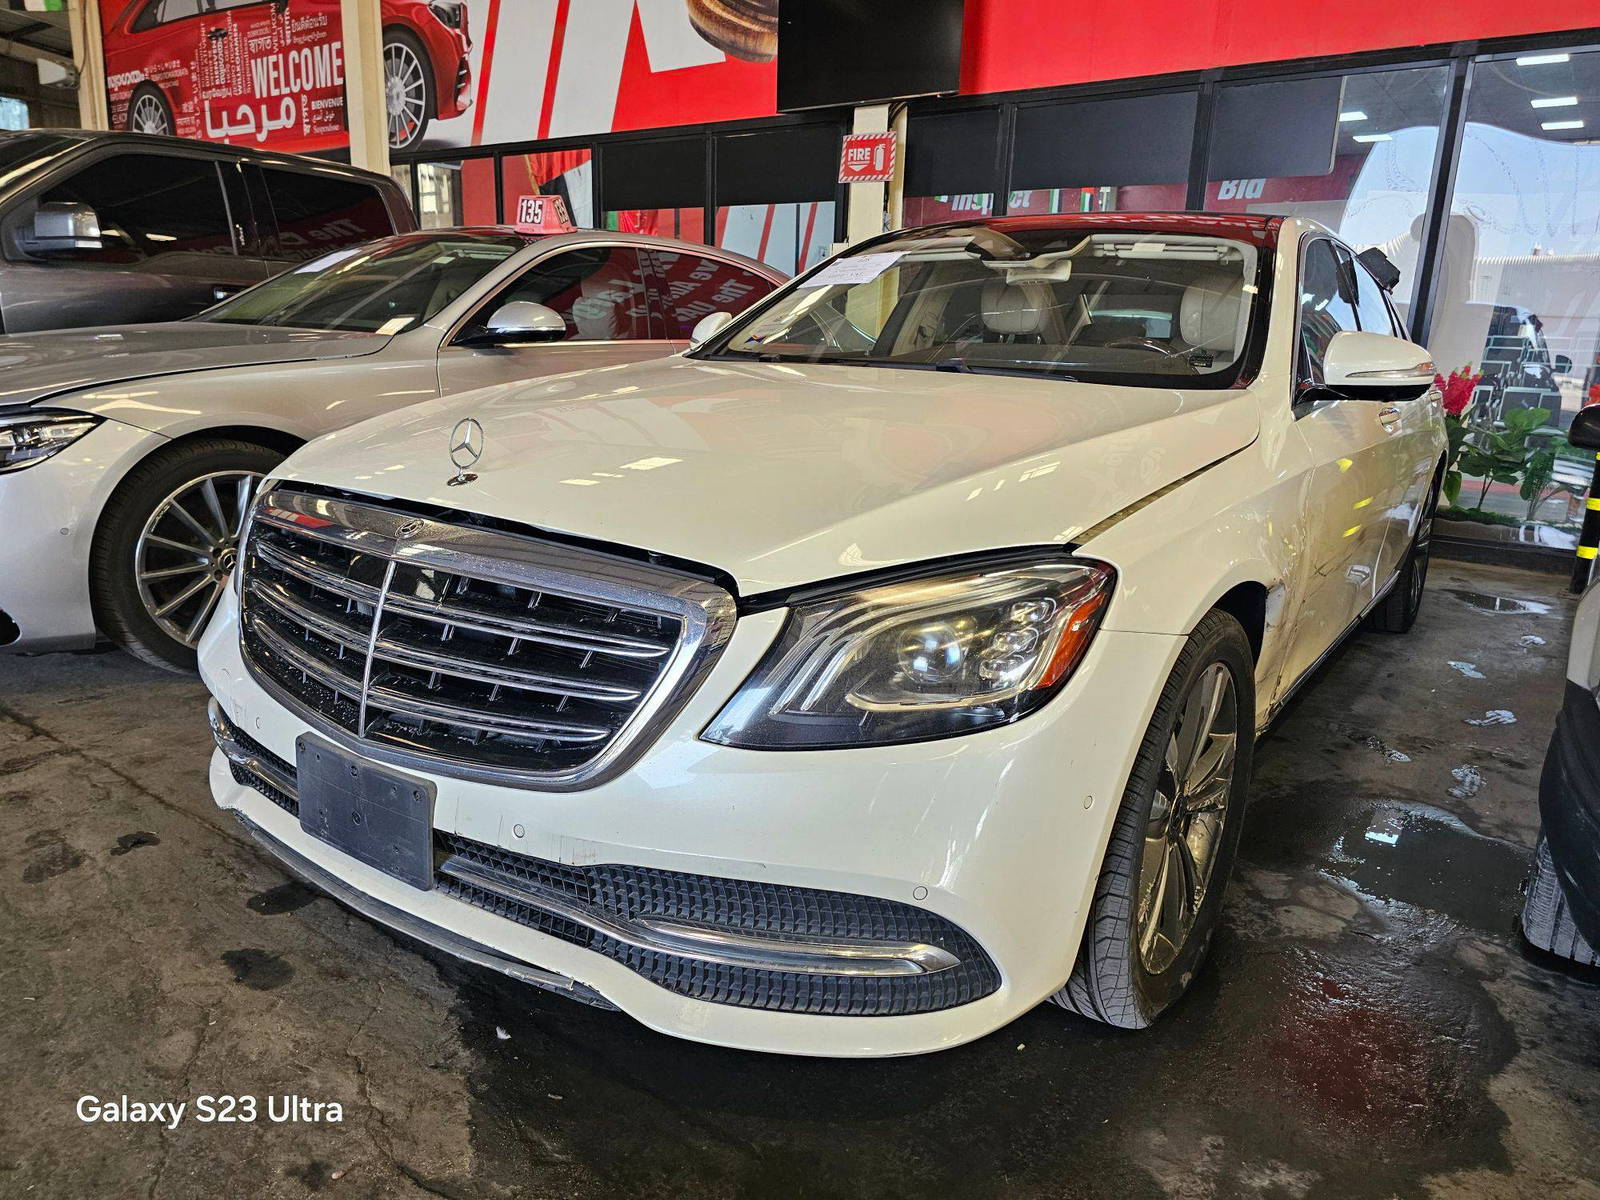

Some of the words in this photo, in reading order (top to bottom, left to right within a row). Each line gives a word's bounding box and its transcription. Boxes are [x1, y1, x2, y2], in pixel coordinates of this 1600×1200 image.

[251, 41, 344, 99] WELCOME
[311, 97, 343, 110] BIENVENUE
[204, 96, 296, 146] مرحبا
[848, 147, 871, 161] FIRE
[520, 199, 544, 224] 135
[951, 190, 1034, 216] Inspct
